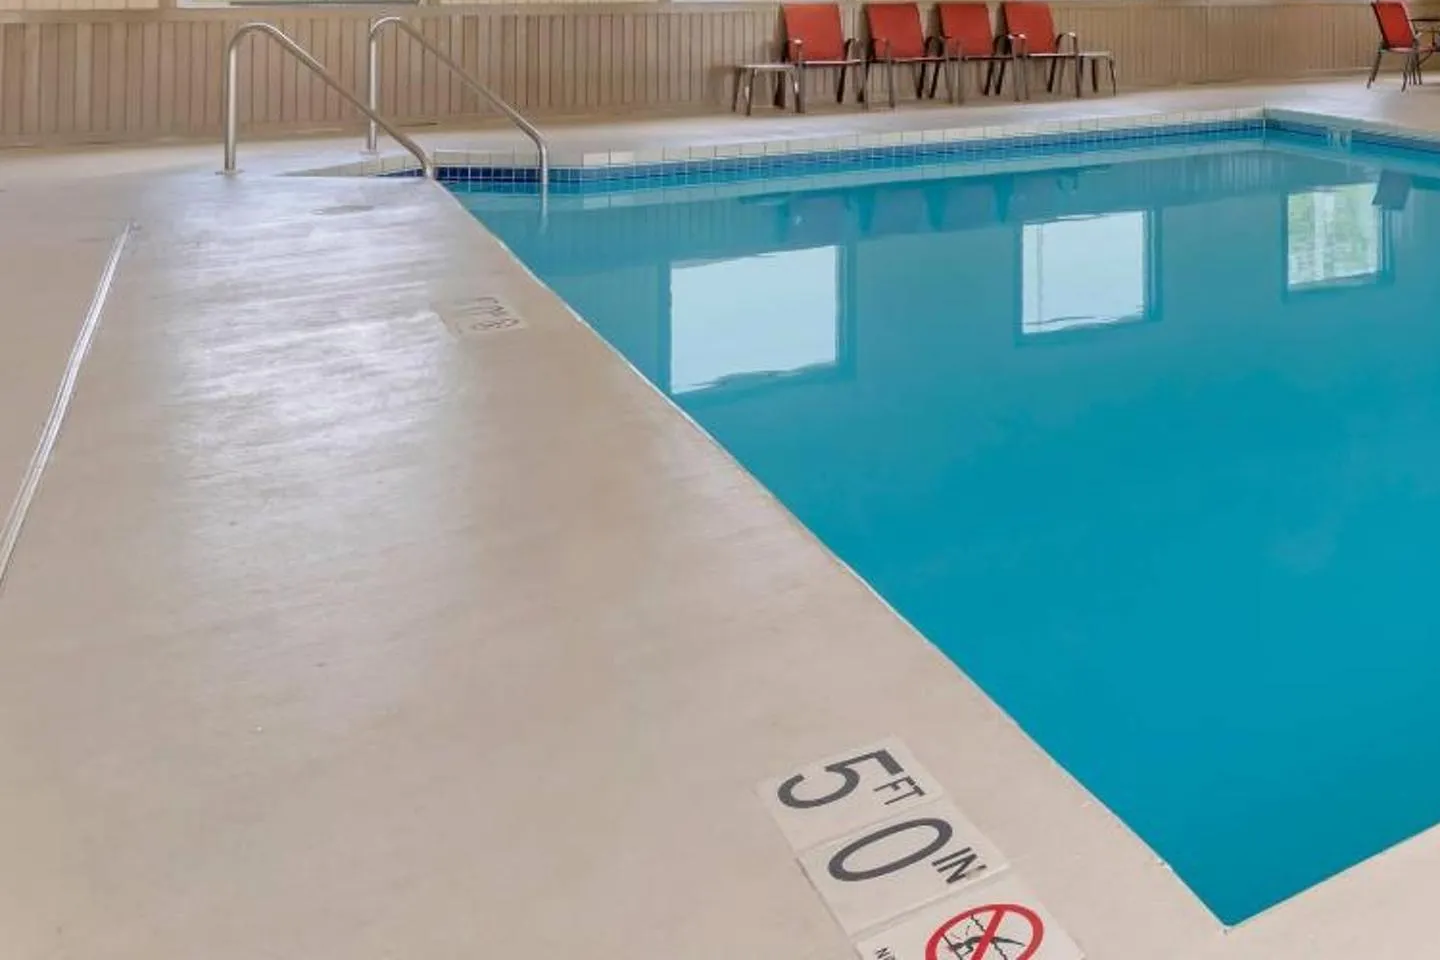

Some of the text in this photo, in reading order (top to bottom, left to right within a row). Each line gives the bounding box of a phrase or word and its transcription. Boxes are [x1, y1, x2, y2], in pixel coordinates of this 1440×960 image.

[777, 749, 988, 885] 5 FT 0 IN
